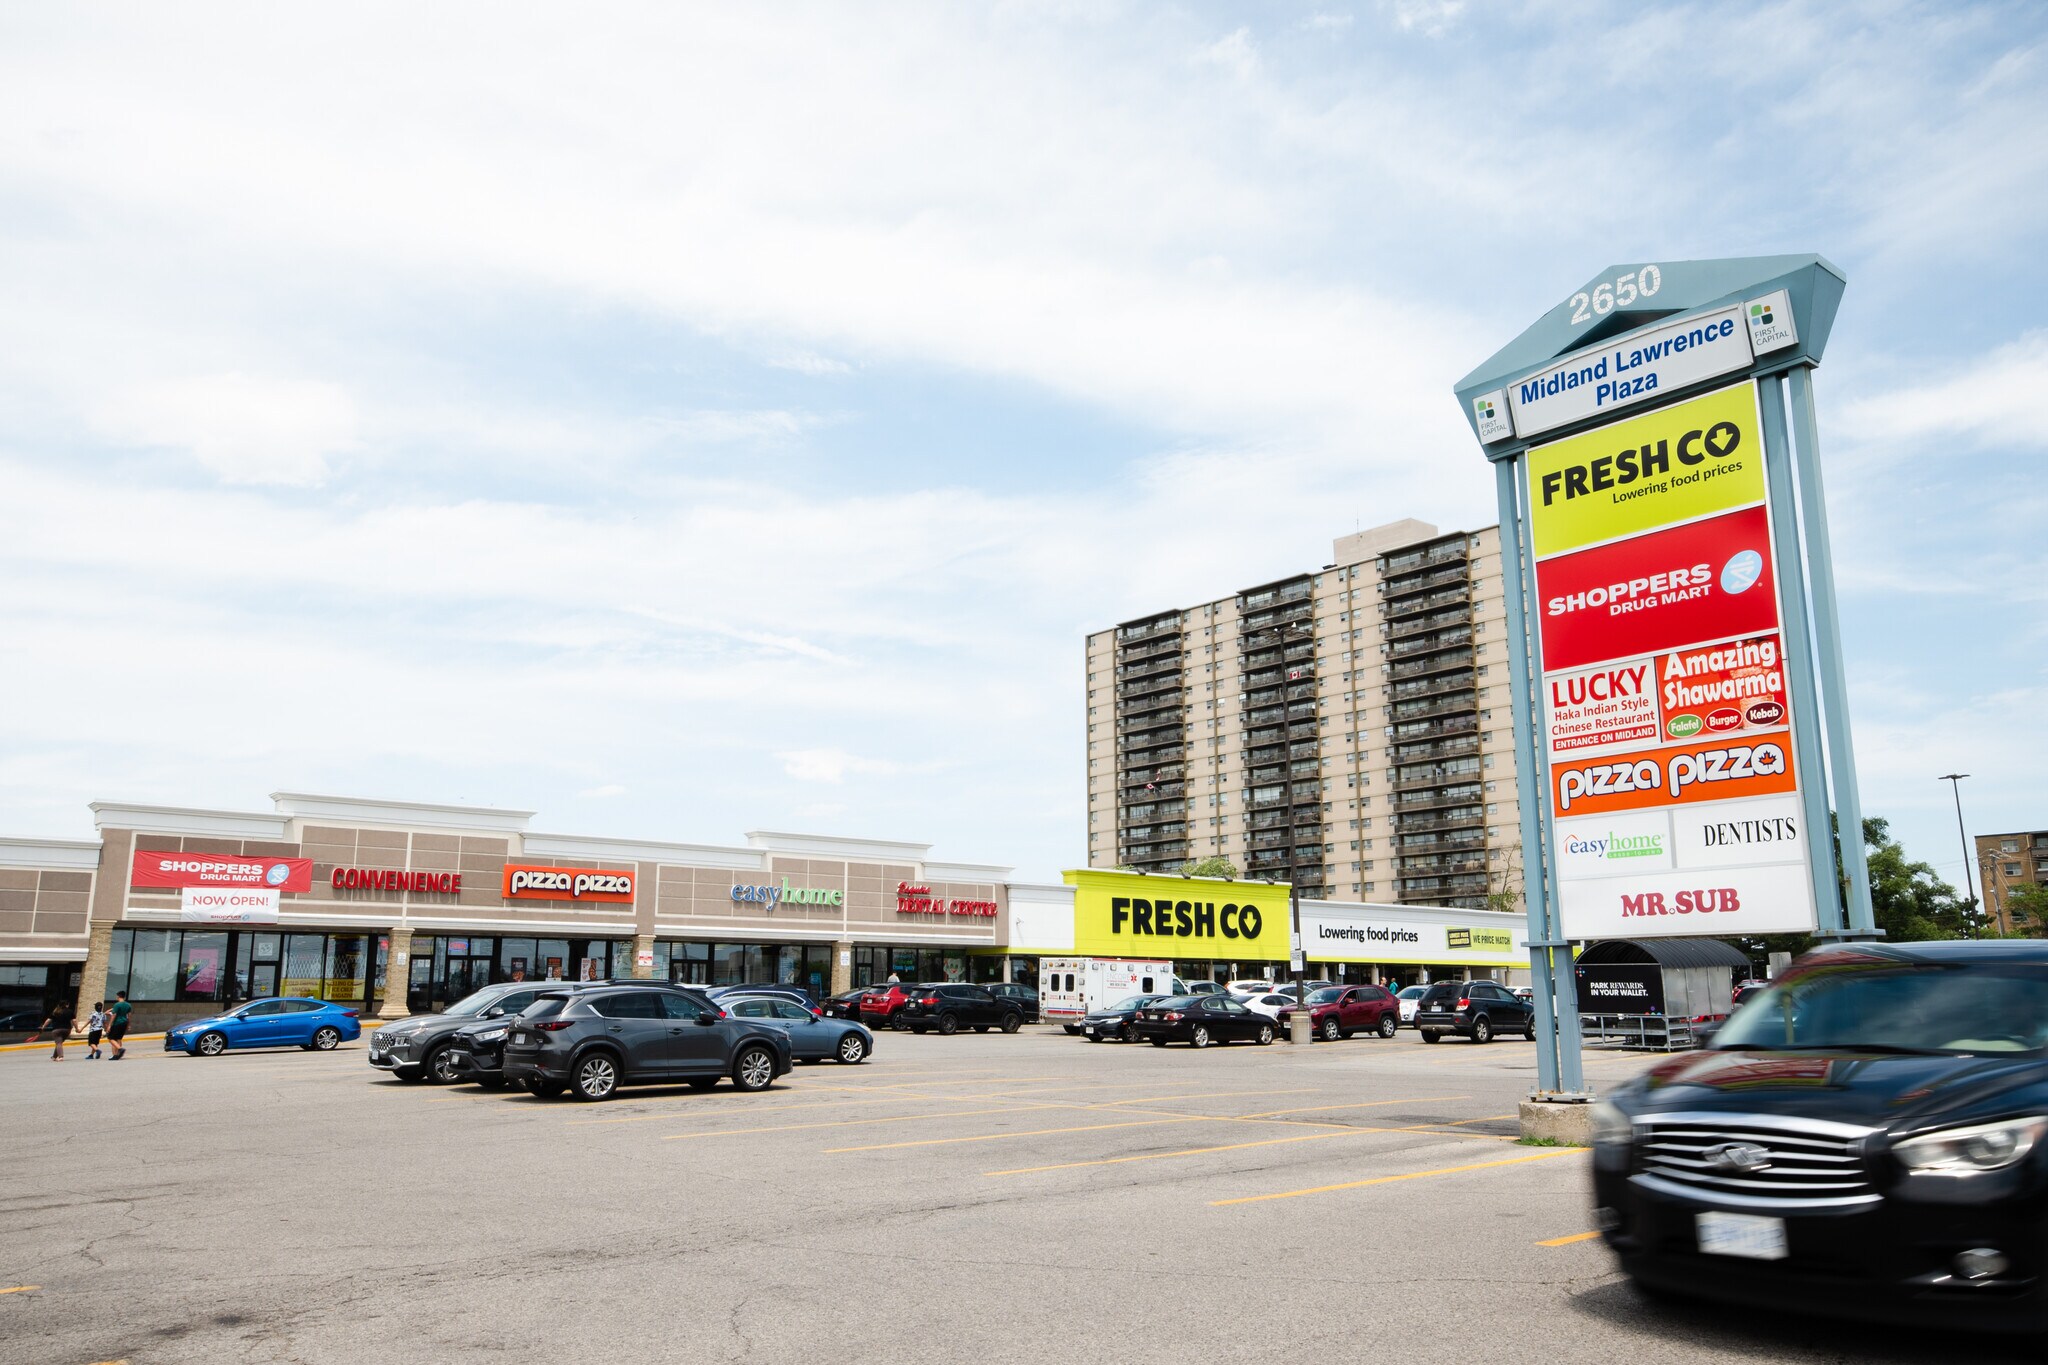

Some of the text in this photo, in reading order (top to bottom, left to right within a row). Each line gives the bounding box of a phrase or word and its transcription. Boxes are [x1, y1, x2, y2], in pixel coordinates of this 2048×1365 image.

[1570, 265, 1661, 325] 2650
[1755, 326, 1776, 339] FIRST
[1756, 330, 1789, 347] CAPITAL
[1521, 318, 1734, 404] Midland Lawrence
[1596, 371, 1658, 406] Plaza
[1481, 420, 1498, 430] FIRST
[1482, 424, 1507, 437] CAPITAL
[1542, 439, 1669, 506] FRESH
[1613, 461, 1743, 504] Lowering food prices
[1548, 563, 1712, 616] SHOPPERS
[1610, 584, 1712, 616] DRUG MART
[1664, 641, 1776, 681] Amazing
[1552, 665, 1647, 708] LUCKY
[1664, 671, 1782, 710] Shawarma
[1555, 697, 1649, 722] Haka Indian Style
[1709, 713, 1739, 728] Burger
[1749, 704, 1779, 721] Kebab
[1552, 710, 1655, 736] Chinese Restaurant
[1670, 718, 1699, 733] Falafel
[1555, 726, 1654, 749] ENTRANCE ON MIDLAND
[1559, 743, 1786, 810] pizza pizza
[1570, 831, 1662, 858] easyhome
[1704, 816, 1796, 847] DENTISTS
[159, 860, 264, 875] SHOPPERS
[200, 873, 262, 882] DRUG MART
[331, 867, 462, 893] CONVENIENCE
[510, 870, 632, 898] pizza pizza
[731, 877, 843, 911] easyhome
[897, 882, 931, 896] Esquire
[193, 896, 269, 907] NOW OPEN!
[897, 897, 998, 916] DENTAL CENTRE
[1112, 897, 1215, 937] FRESH
[1319, 924, 1418, 944] Lowering food prices
[1473, 935, 1480, 944] WE
[1481, 936, 1494, 945] PRICE
[1495, 936, 1510, 945] MATCH
